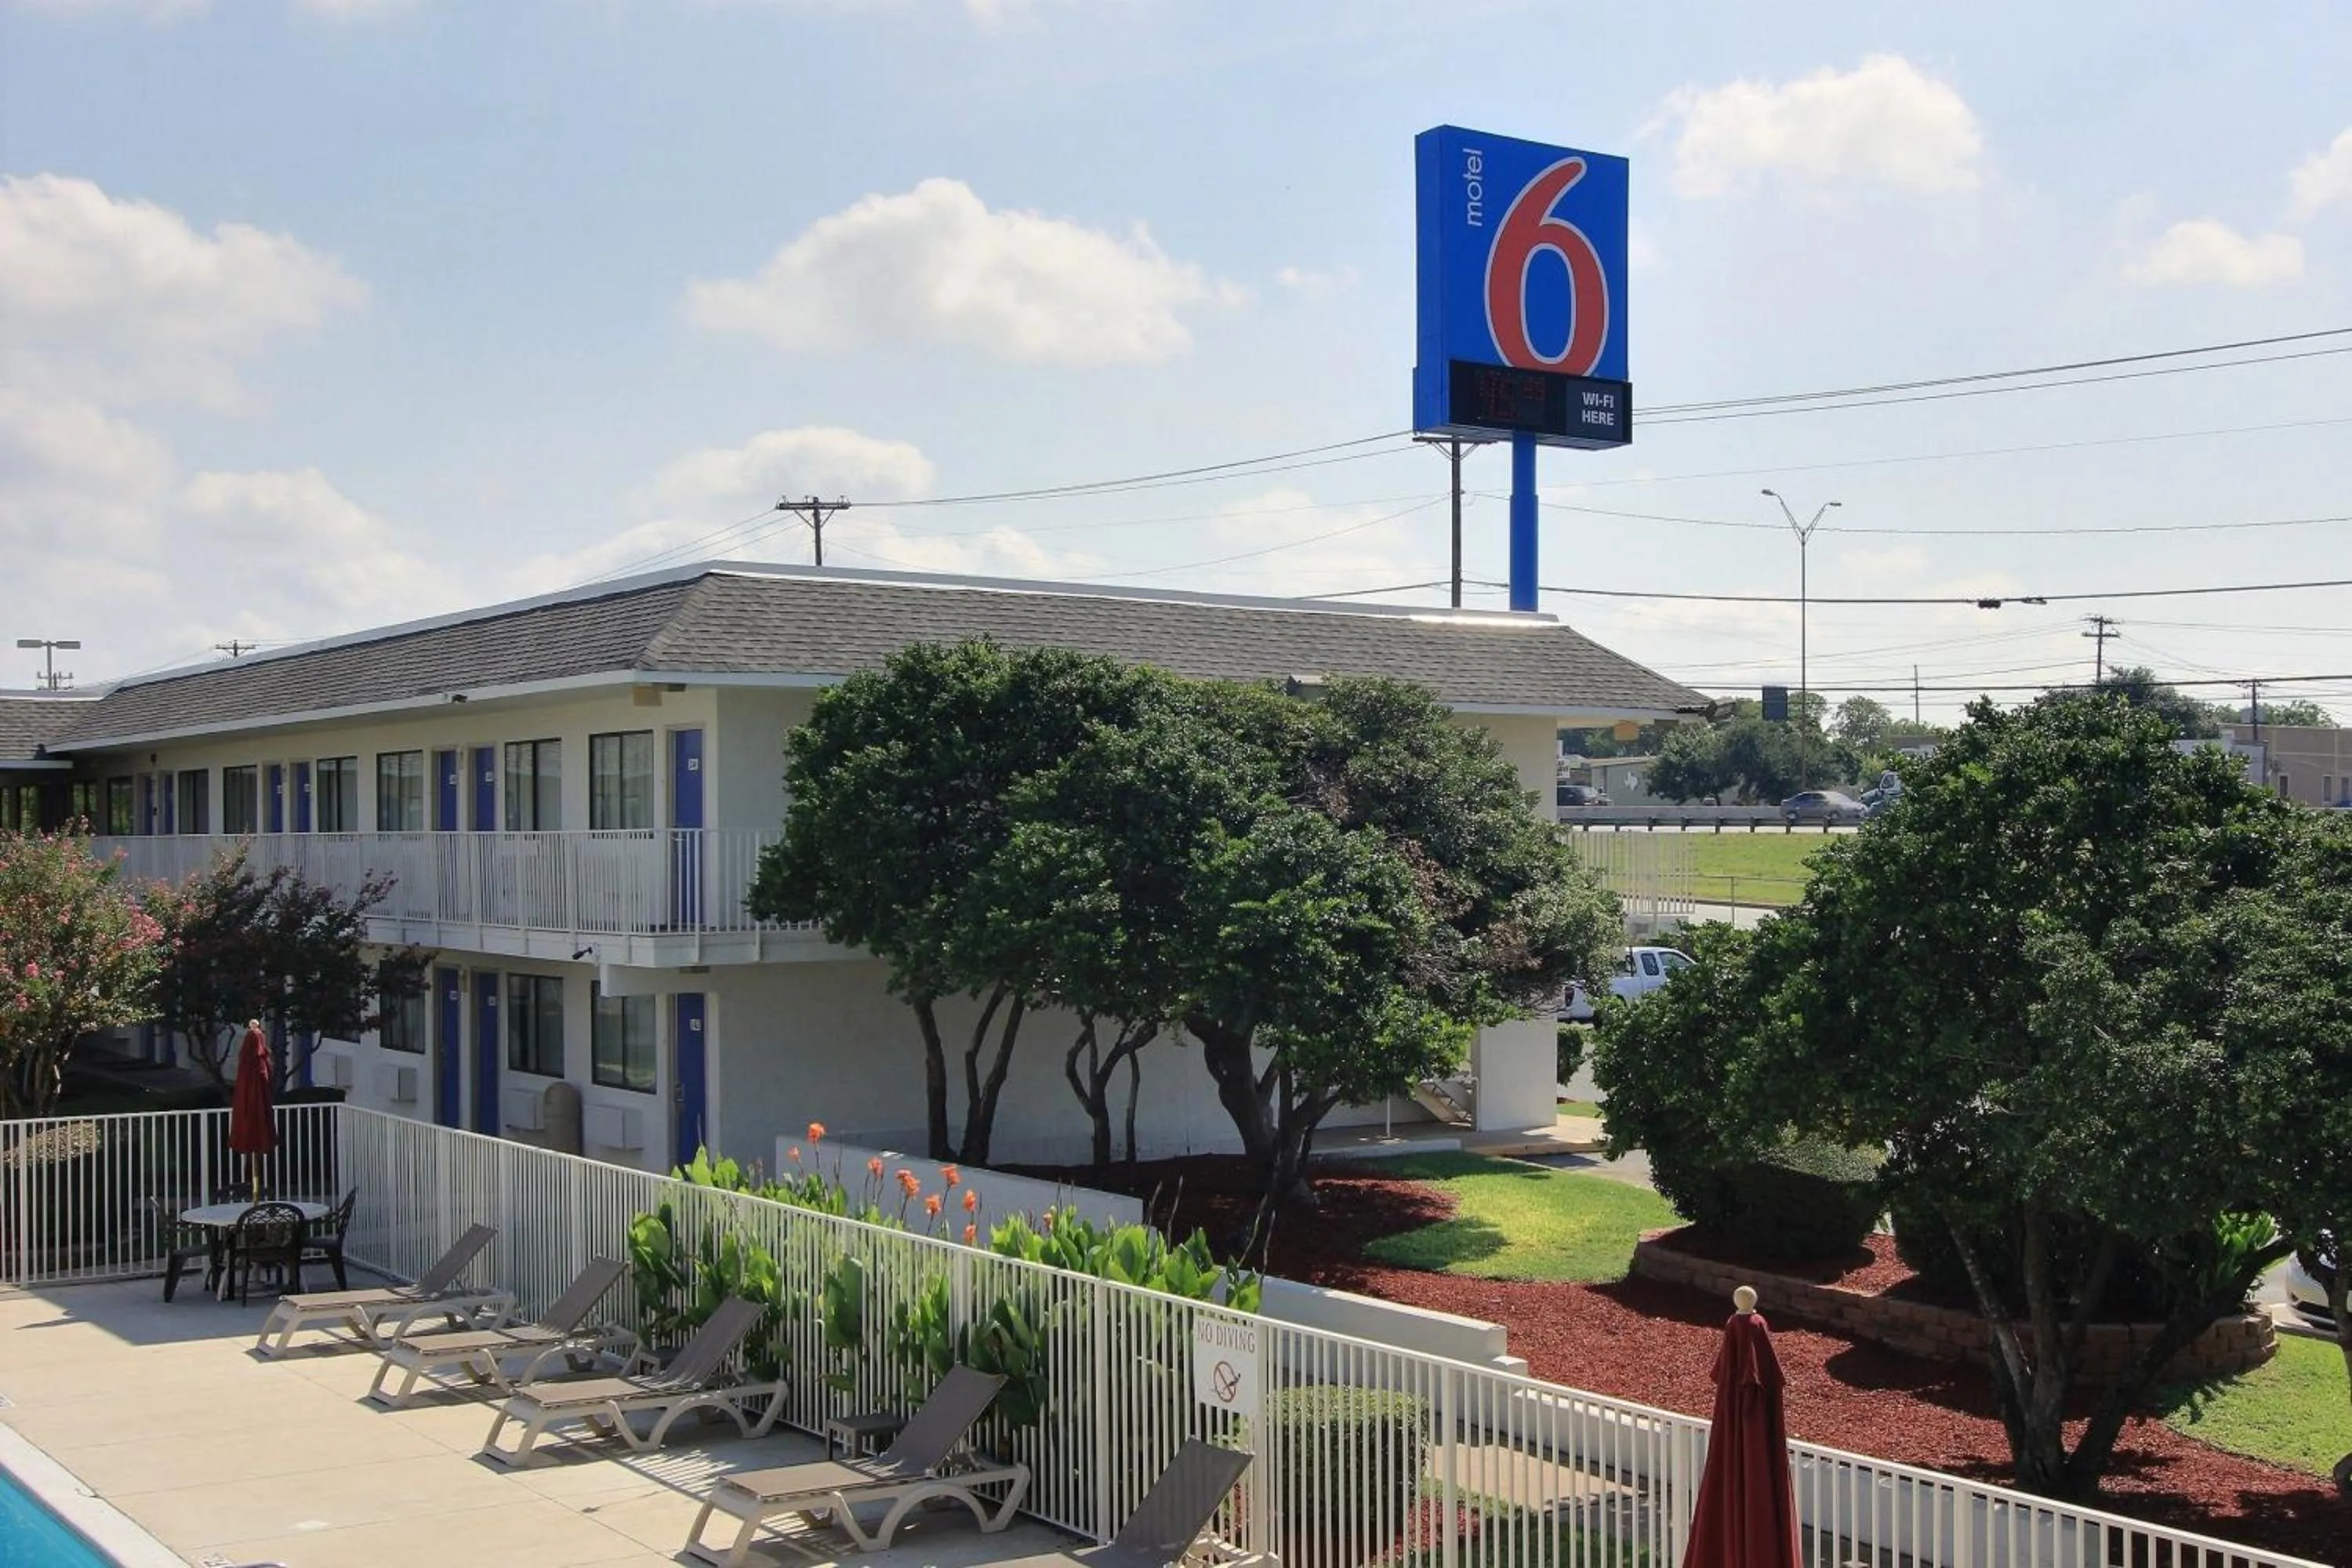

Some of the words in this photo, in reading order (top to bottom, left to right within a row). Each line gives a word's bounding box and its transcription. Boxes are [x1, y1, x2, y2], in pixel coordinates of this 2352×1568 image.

[1462, 148, 1483, 227] motel
[1484, 156, 1610, 376] 6
[1582, 391, 1614, 408] WI-FI
[1582, 410, 1614, 426] HERE
[1197, 1321, 1213, 1343] NO
[1216, 1325, 1255, 1354] DIVING
